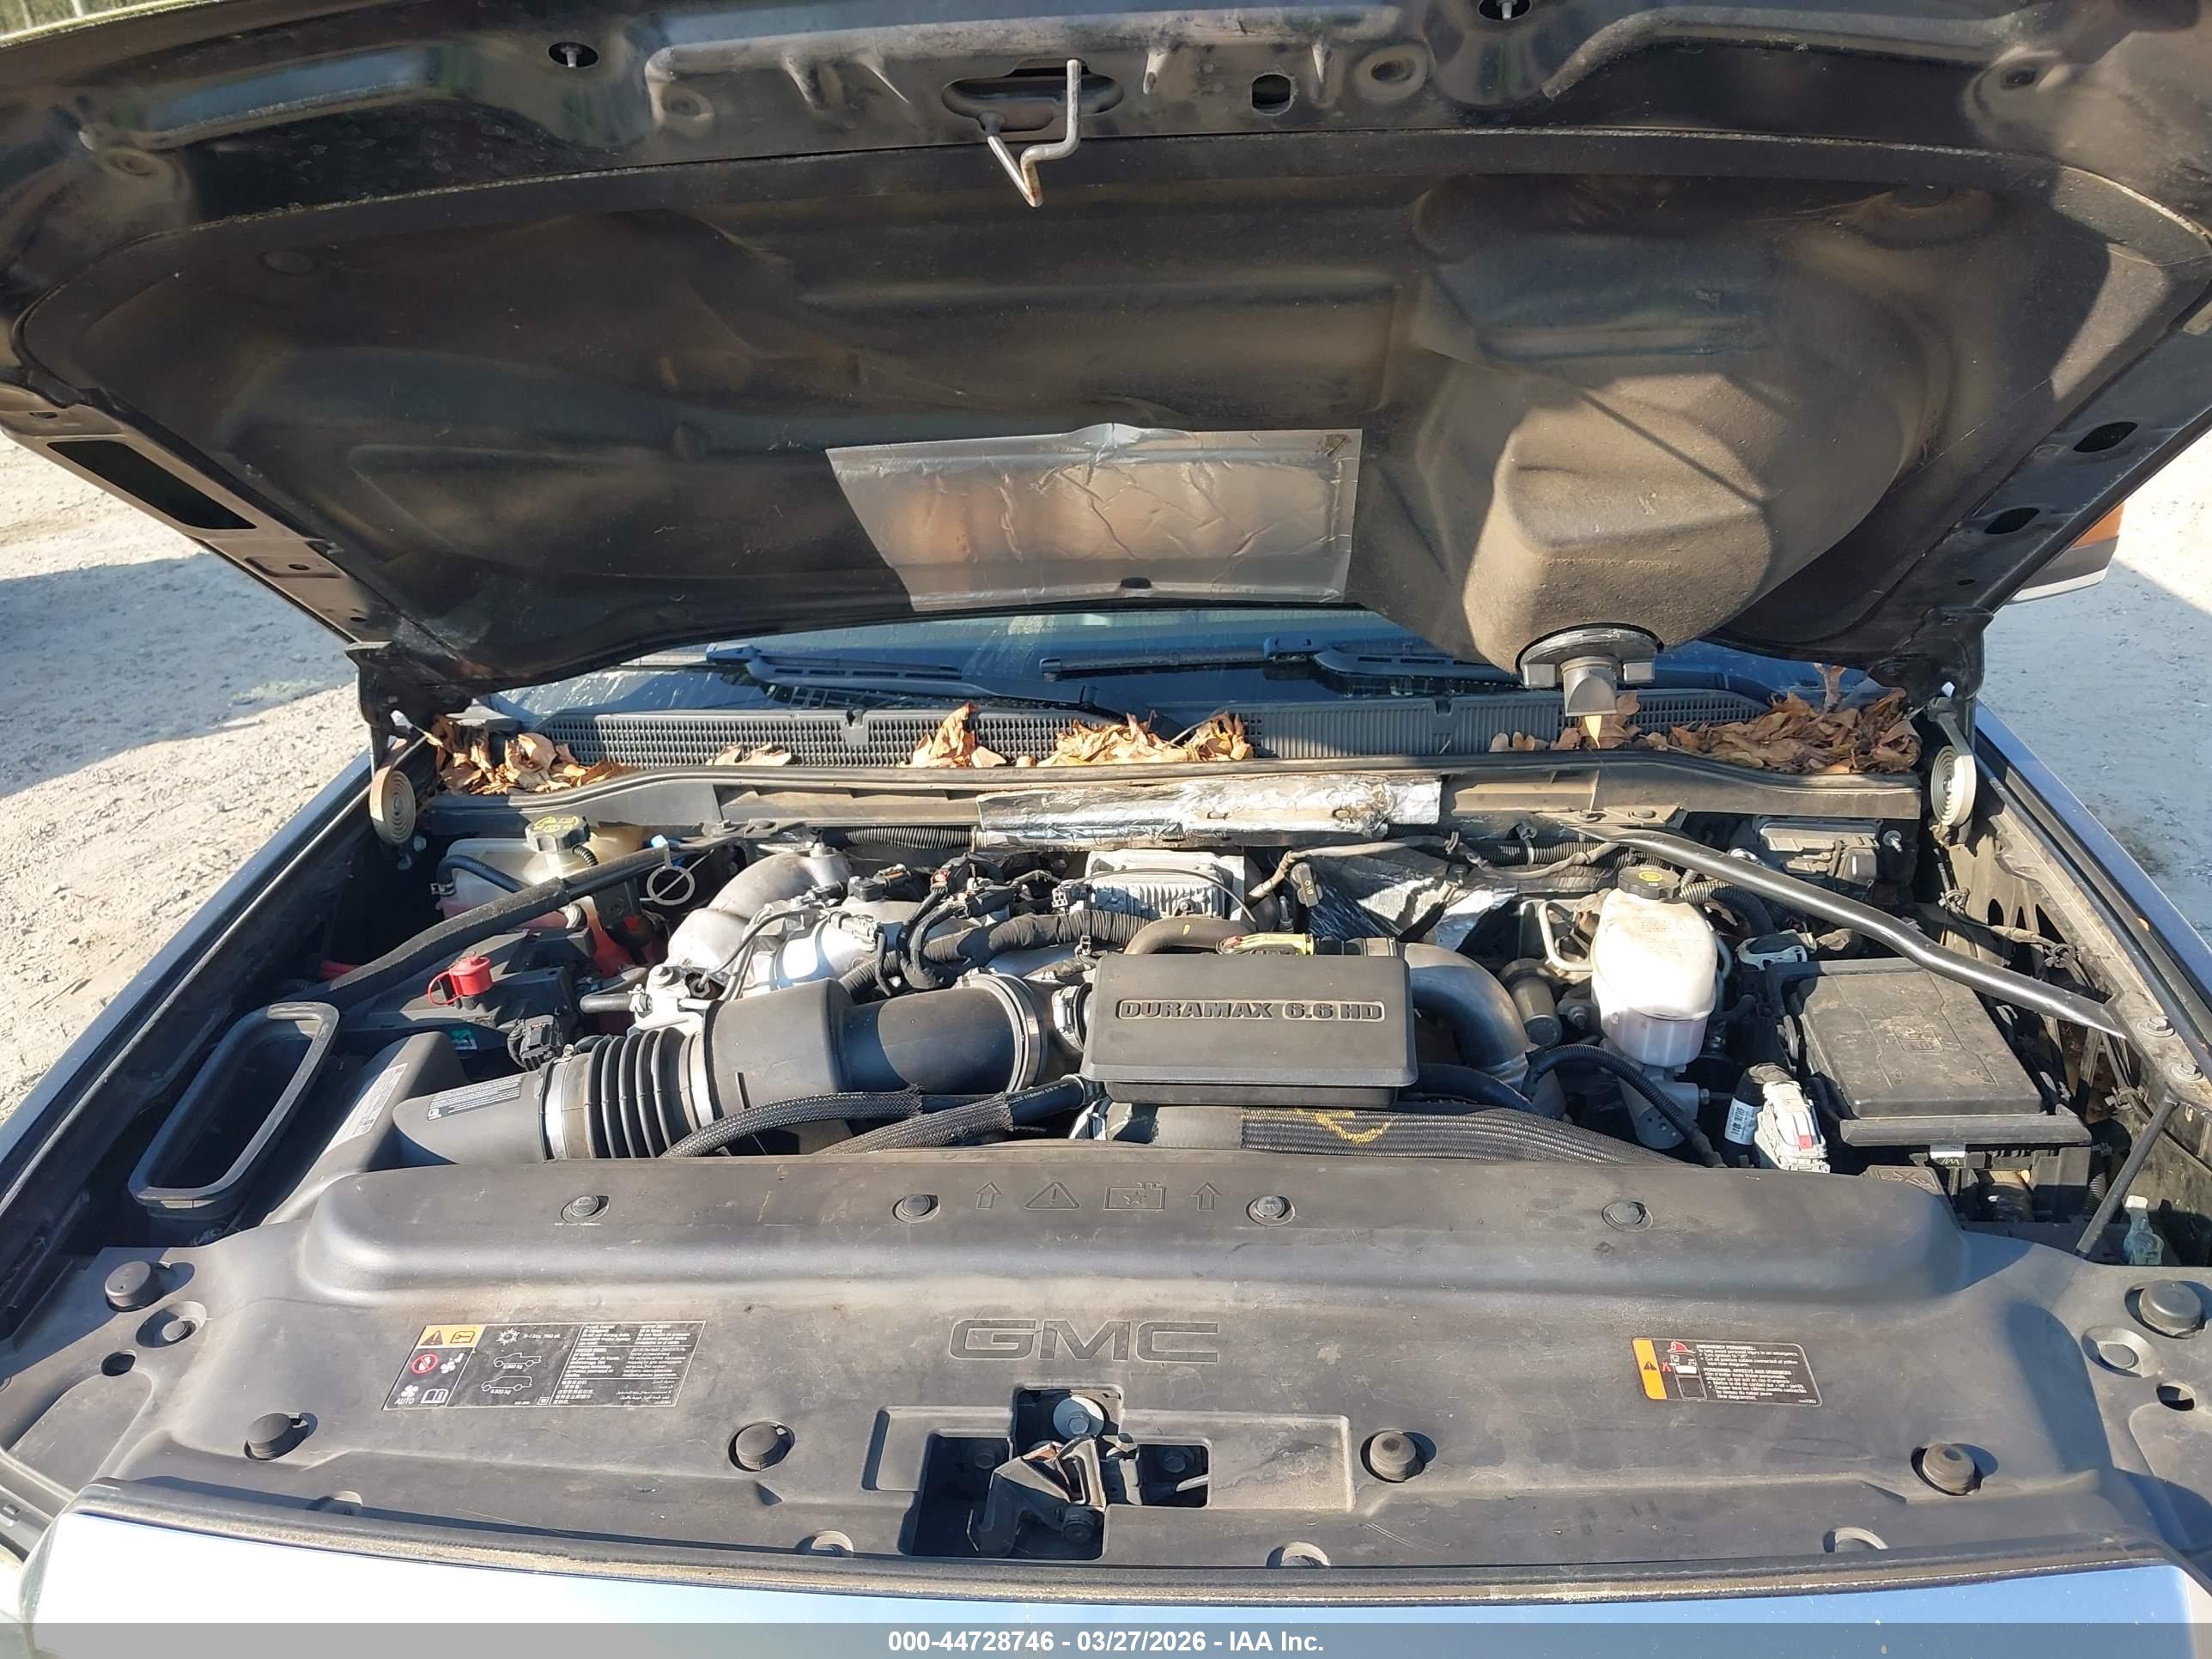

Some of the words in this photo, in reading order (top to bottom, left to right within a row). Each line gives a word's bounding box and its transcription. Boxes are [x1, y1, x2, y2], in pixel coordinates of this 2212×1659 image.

[1120, 1001, 1273, 1019] DURAMAX
[1283, 1001, 1333, 1019] 6.6
[1340, 1003, 1382, 1020] HD
[1024, 1091, 1045, 1099] (16mm)
[948, 1318, 1218, 1364] GMC
